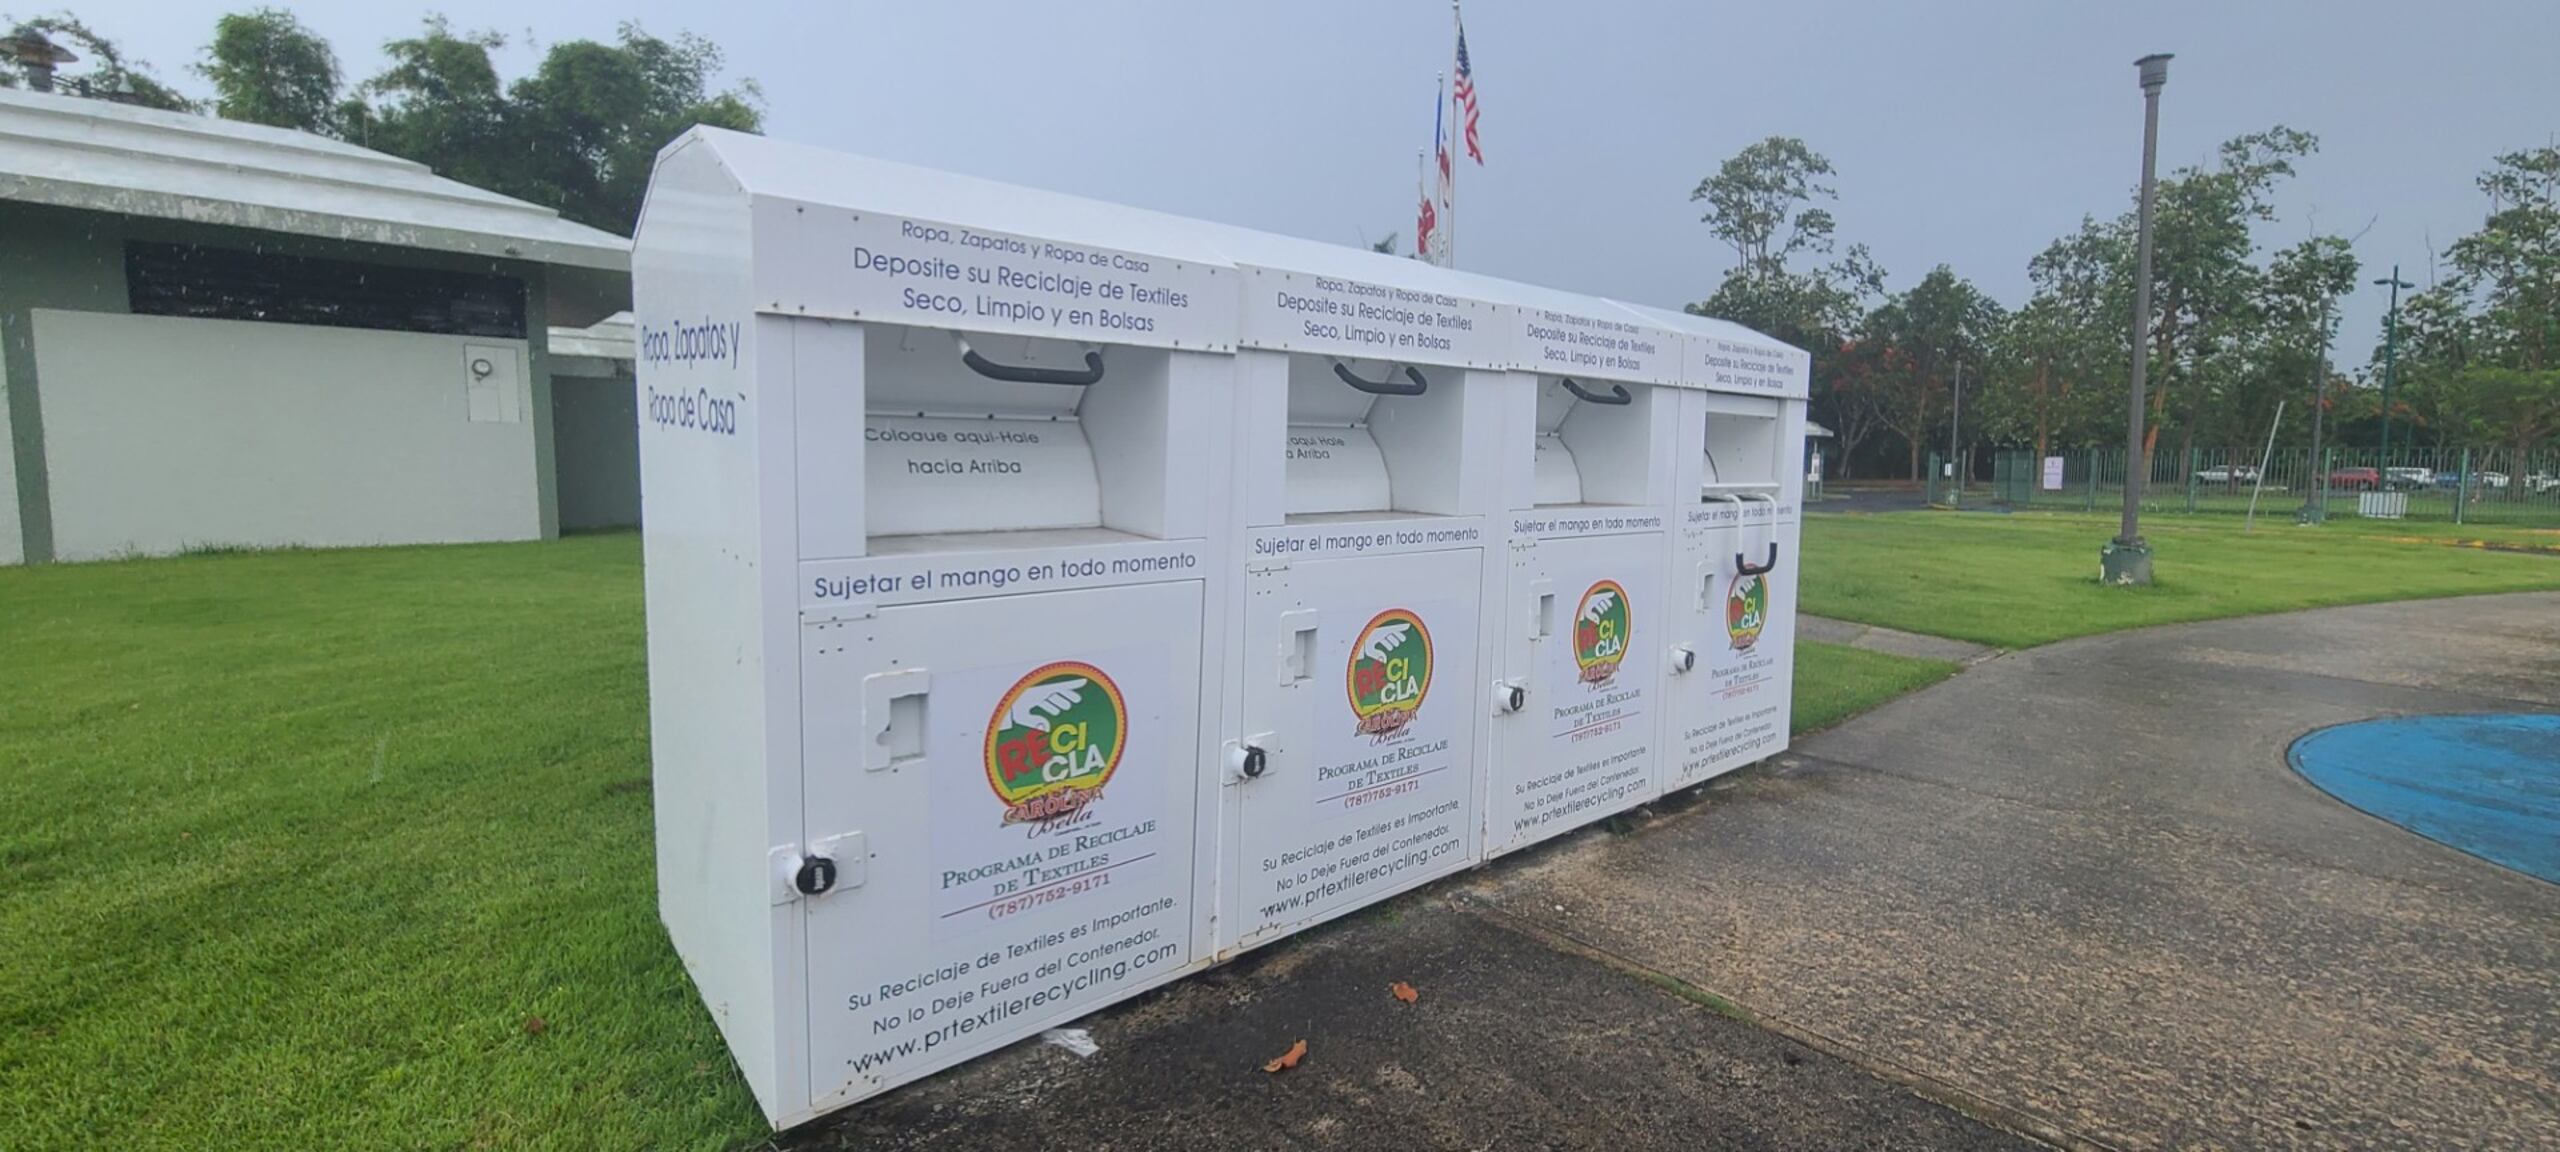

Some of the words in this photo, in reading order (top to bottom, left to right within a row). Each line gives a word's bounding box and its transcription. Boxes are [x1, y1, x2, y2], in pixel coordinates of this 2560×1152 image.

[901, 220, 954, 245] Ropa,
[961, 231, 1026, 254] Zapatos
[1031, 244, 1040, 259] y
[1044, 244, 1084, 264] Ropa
[1089, 252, 1108, 267] de
[1113, 256, 1149, 273] Casa
[854, 247, 960, 281] Deposite
[967, 266, 990, 284] su
[998, 266, 1092, 298] Reciclaje
[1099, 280, 1124, 300] de
[1130, 282, 1189, 309] Textiles
[1348, 281, 1386, 298] Zapatos
[1389, 290, 1394, 300] y
[1396, 289, 1419, 303] Ropa
[1421, 292, 1433, 304] de
[1436, 295, 1457, 307] Casa
[903, 288, 968, 315] Seco,
[977, 295, 1045, 322] Limpio
[1051, 308, 1063, 326] y
[1069, 309, 1093, 326] en
[1100, 309, 1154, 332] Bolsas
[1277, 292, 1338, 316] Deposite
[1340, 303, 1354, 317] su
[1358, 303, 1414, 325] Reciclaje
[1417, 311, 1433, 326] de
[1436, 313, 1472, 331] Textiles
[642, 324, 670, 370] Ropa,
[674, 314, 726, 369] Zapatos
[729, 321, 739, 370] y
[1304, 320, 1341, 341] Seco,
[1345, 325, 1385, 345] Limpio
[1389, 334, 1396, 348] y
[1399, 333, 1414, 346] en
[1418, 333, 1450, 350] Bolsas
[1527, 324, 1566, 341] Deposite
[1568, 333, 1577, 343] su
[1579, 332, 1616, 350] Reciclaje
[1618, 338, 1629, 350] de
[1570, 350, 1597, 366] Limpio
[1599, 356, 1605, 368] y
[1606, 354, 1616, 366] en
[1618, 355, 1640, 371] Bolsas
[648, 385, 675, 432] Ropa
[678, 386, 694, 428] de
[698, 387, 735, 436] Casa
[907, 458, 964, 474] hacia
[969, 459, 1022, 474] Arriba
[1255, 536, 1304, 556] Sujetar
[1309, 534, 1321, 550] el
[1326, 531, 1373, 551] mango
[1376, 531, 1392, 546] en
[1396, 529, 1424, 545] todo
[1426, 527, 1479, 543] momento
[1514, 519, 1546, 535] Sujetar
[1548, 520, 1557, 531] el
[1559, 519, 1590, 533] mango
[1592, 519, 1603, 531] en
[1605, 517, 1624, 529] todo
[1626, 516, 1661, 528] momento
[814, 573, 902, 601] Sujetar
[910, 571, 931, 591] el
[940, 567, 1021, 588] mango
[1027, 563, 1054, 581] en
[1060, 558, 1106, 578] todo
[1112, 553, 1197, 574] momento
[1042, 744, 1105, 783] CLA
[1564, 769, 1575, 780] de
[1344, 779, 1419, 809] (787)752-9171
[1262, 858, 1277, 872] Su
[1281, 840, 1335, 866] Reciclaje
[1338, 834, 1353, 847] de
[1355, 822, 1391, 843] Textiles
[1394, 817, 1405, 828] es
[1262, 837, 1460, 918] www.prtextilerecycling.com
[1276, 878, 1293, 893] No
[1296, 870, 1308, 884] lo
[1311, 862, 1336, 880] Deje
[1340, 852, 1370, 870] Fuera
[1372, 846, 1389, 859] del
[988, 873, 1111, 920] (787)752-9171
[848, 994, 872, 1011] Su
[880, 961, 970, 1001] Reciclaje
[976, 952, 1000, 969] de
[1007, 931, 1065, 960] Textiles
[1070, 924, 1087, 939] es
[1092, 897, 1177, 933] Importante.
[873, 1016, 901, 1035] No
[908, 1008, 925, 1024] lo
[932, 991, 974, 1015] Deje
[981, 971, 1029, 998] Fuera
[1035, 958, 1062, 979] del
[1067, 927, 1160, 968] Contenedor.
[853, 943, 1177, 1074] www.prtextilerecycling.com
